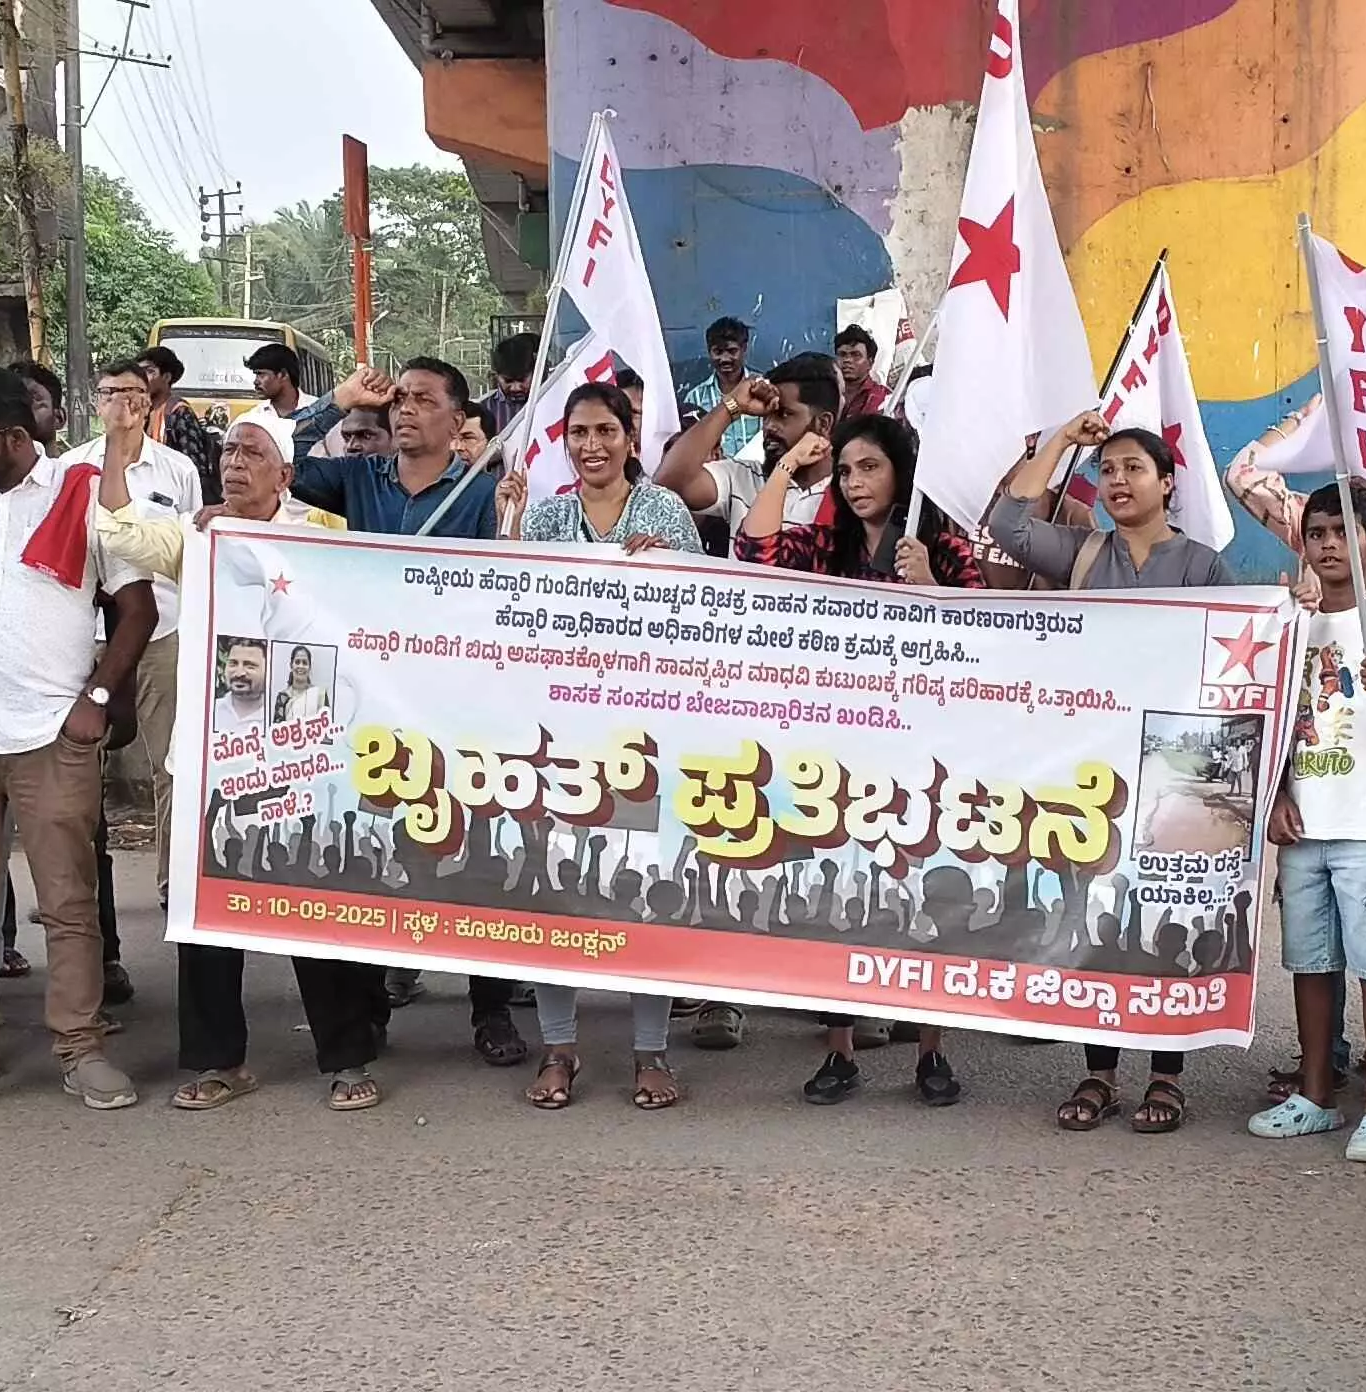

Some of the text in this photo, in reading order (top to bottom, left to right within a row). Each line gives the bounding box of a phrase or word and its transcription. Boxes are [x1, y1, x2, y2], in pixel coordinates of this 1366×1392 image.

[479, 568, 530, 601] ಹೆದ್ದಾರಿ
[536, 572, 629, 611] ಗುಂಡಿಗಳನ್ನು
[633, 581, 697, 614] ಮುಚ್ಚದೆ
[701, 585, 747, 617] ದ್ವಿಚಕ್ರ
[752, 592, 808, 615] ವಾಹನ
[812, 597, 878, 620] ಸವಾರರ
[883, 603, 937, 625] ಸಾವಿಗೆ
[941, 607, 1084, 641] ಕಾರಣರಾಗುತ್ತಿರುವ
[495, 604, 547, 638] ಹೆದ್ದಾರಿ
[552, 610, 642, 639] ಪ್ರಾಧಿಕಾರದ
[647, 618, 742, 646] ಅಧಿಕಾರಿಗಳ
[747, 624, 794, 648] ಮೇಲೆ
[798, 628, 840, 652] ಕಠಿಣ
[844, 632, 898, 666] ಕ್ರಮಕ್ಕೆ
[347, 627, 400, 660] ಹೆದ್ದಾರಿ
[404, 632, 461, 658] ಗುಂಡಿಗೆ
[465, 639, 504, 670] ಬಿದ್ದು
[655, 655, 744, 689] ಸಾವನ್ನಪ್ಪಿದ
[748, 661, 810, 689] ಮಾಧವಿ
[815, 666, 900, 703] ಕುಟುಂಬಕ್ಕೆ
[950, 677, 1035, 713] ಪರಿಹಾರಕ್ಕೆ
[1200, 685, 1276, 709] DYFI
[549, 682, 601, 705] ಶಾಸಕ
[606, 686, 681, 711] ಸಂಸದರ
[686, 690, 831, 729] ಬೇಜವಾಬ್ದಾರಿತನ
[213, 726, 266, 762] ಮೊನ್ನೆ
[221, 767, 267, 796] ಇಂದು
[352, 724, 1125, 875] ಬೃಹತ್ ಪ್ರತಿಭಟನೆ
[1138, 850, 1241, 882] ಉತ್ತಮ ರಸ್ತೆ
[268, 896, 387, 928] 10-09-2025
[402, 910, 439, 944] ಸ್ಥಳ
[454, 917, 544, 946] ಕೂಳೂರು
[550, 928, 627, 958] ಜಂಕ್ಷನ್
[848, 951, 933, 992] DYFI
[1026, 968, 1121, 1027] ಜಿಲ್ಲಾ
[1128, 976, 1227, 1017] ಸಮಿತಿ
